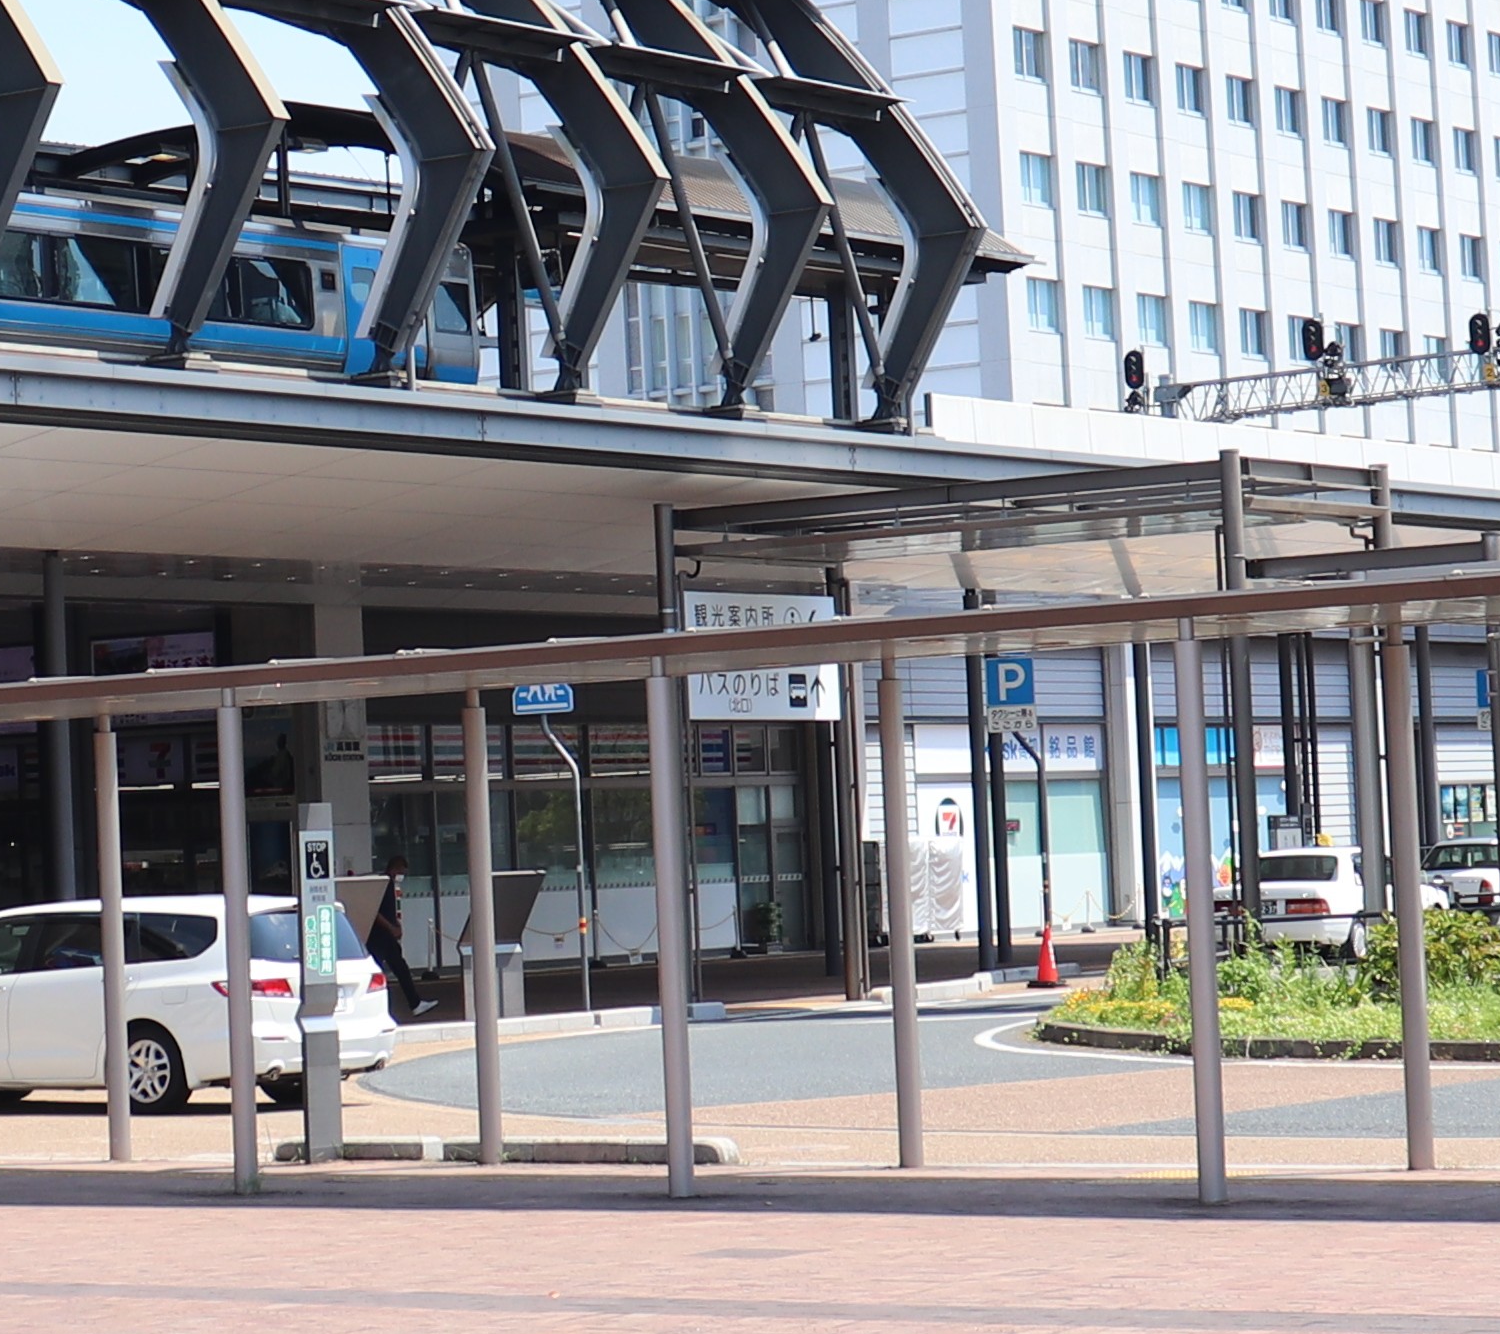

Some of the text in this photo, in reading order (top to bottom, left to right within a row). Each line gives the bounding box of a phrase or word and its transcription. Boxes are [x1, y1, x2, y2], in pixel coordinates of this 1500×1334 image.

[694, 604, 775, 628] 観光案内所
[998, 662, 1026, 702] P
[991, 720, 1034, 730] ここから
[307, 842, 327, 853] STOP
